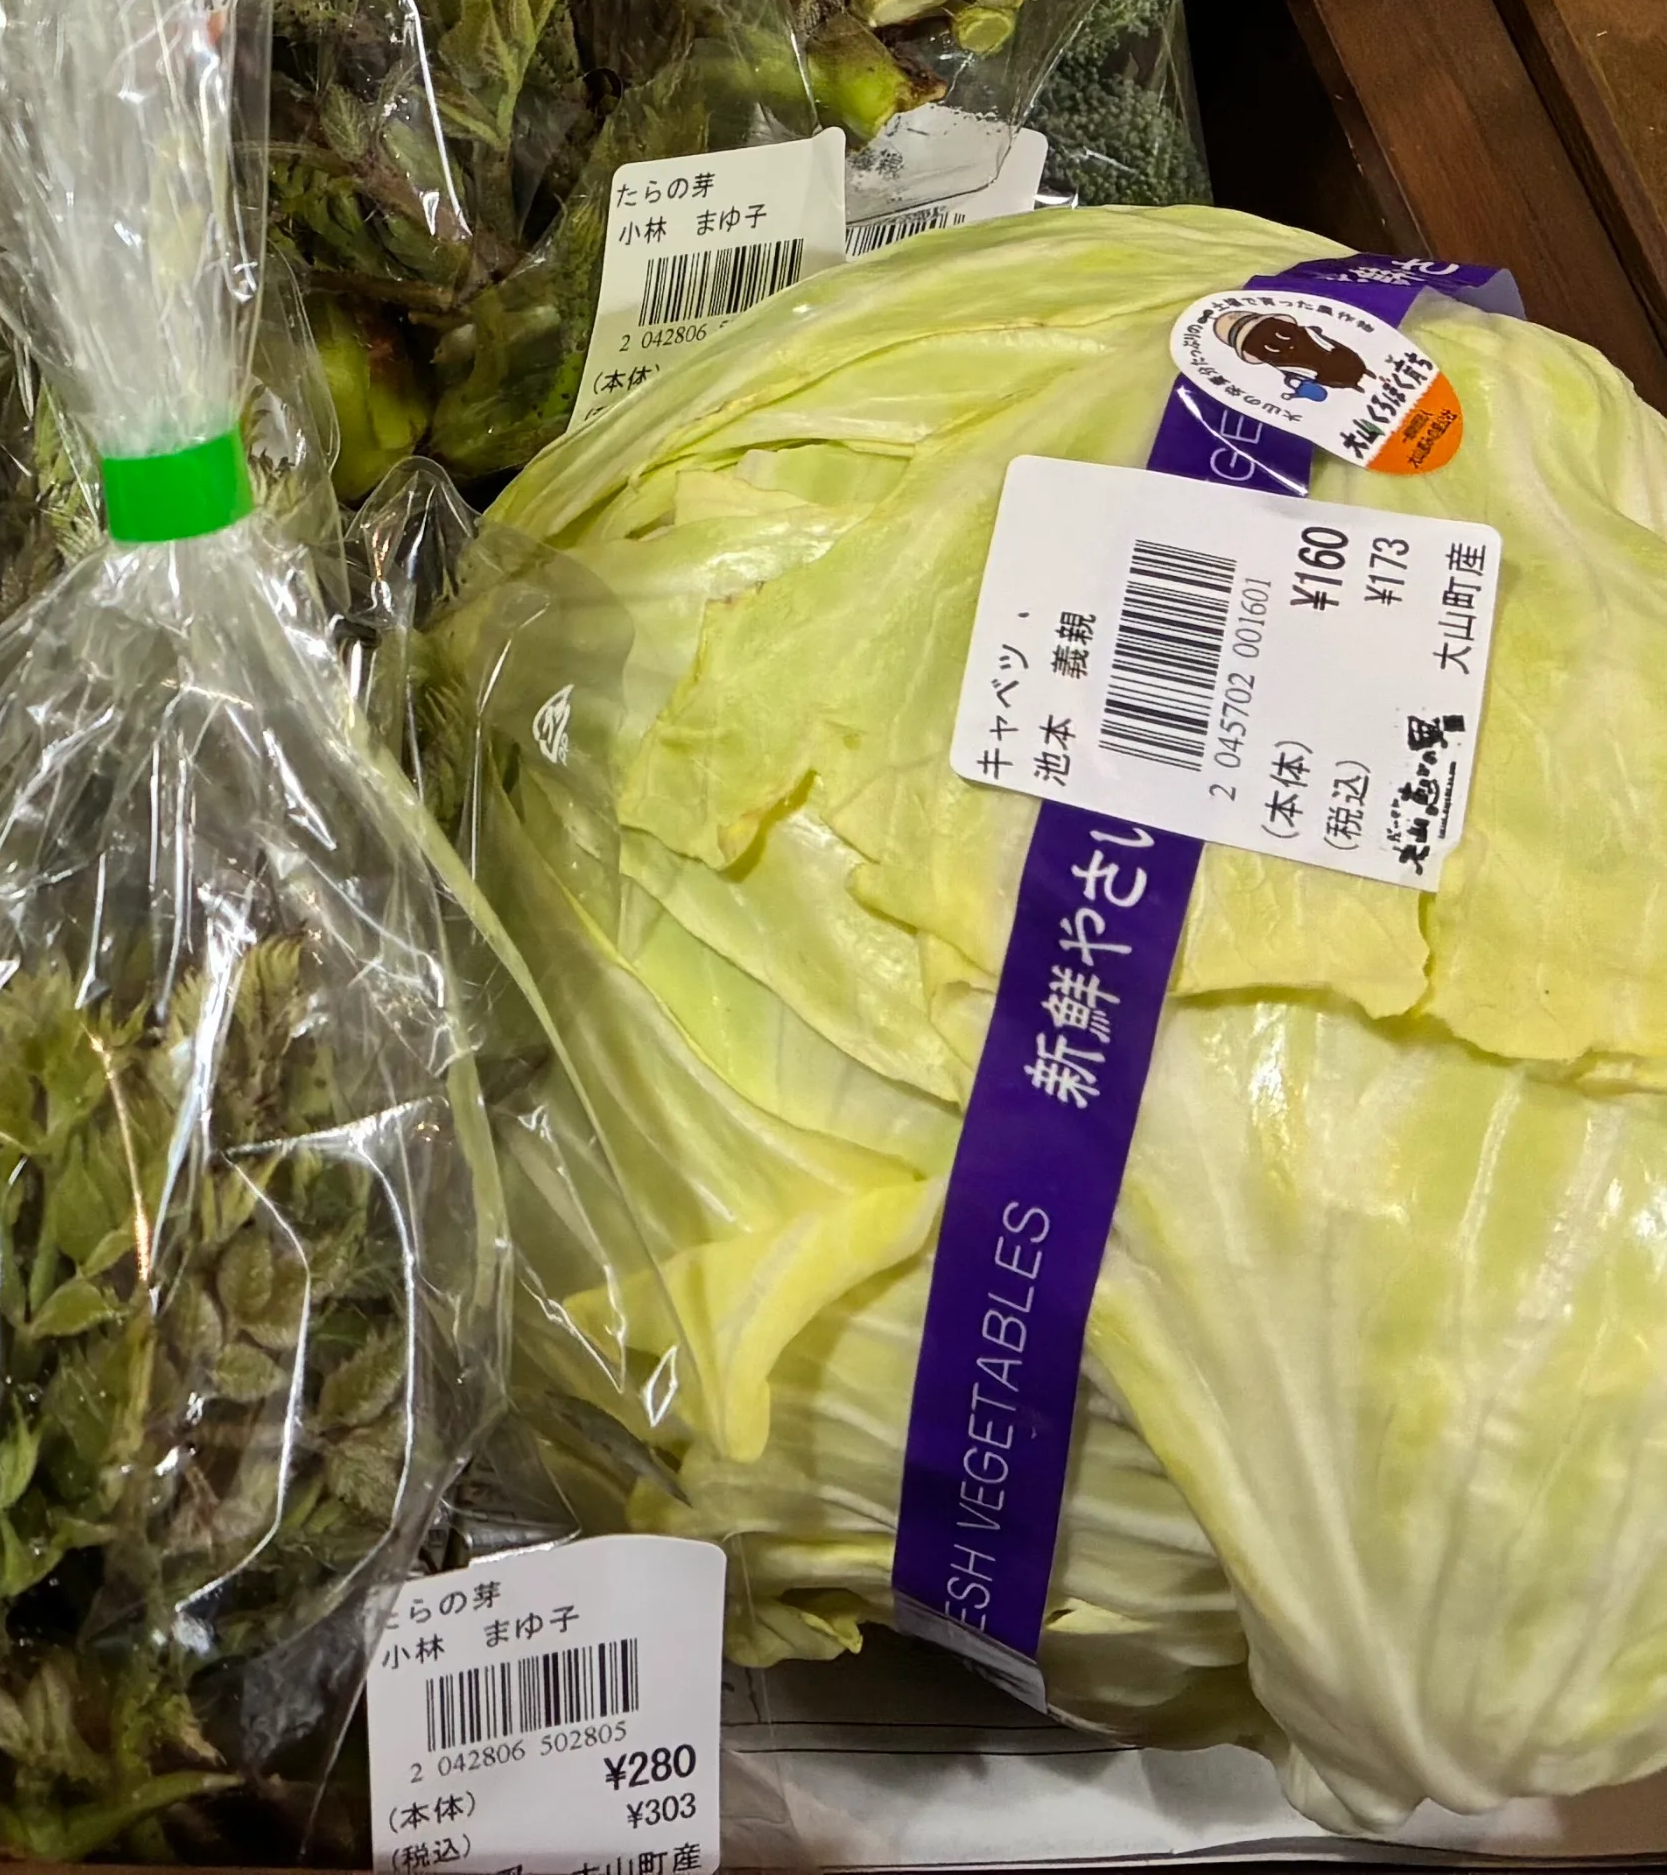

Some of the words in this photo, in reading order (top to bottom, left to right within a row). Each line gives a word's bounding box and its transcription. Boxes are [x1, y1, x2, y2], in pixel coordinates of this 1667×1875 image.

[616, 172, 715, 209] たらの芽
[619, 214, 666, 246] 小林
[696, 205, 767, 237] まゆ子
[641, 323, 707, 350] 042806
[1340, 352, 1434, 460] 大山くろぼく育ち
[1048, 606, 1099, 681] 義親
[1230, 574, 1274, 660] 001601
[1430, 539, 1492, 674] 大山町産
[973, 641, 1033, 783] キャベツ
[1212, 669, 1258, 770] 045702
[1258, 734, 1316, 844] (本体)
[1288, 523, 1352, 614] ¥160
[1320, 755, 1374, 855] (税込)
[1362, 533, 1414, 608] ¥173
[1031, 711, 1079, 788] 池本
[958, 1200, 1053, 1534] VEGETABLES
[381, 1634, 446, 1671] 小林
[484, 1605, 580, 1647] まゆ子
[388, 1790, 477, 1835] (本体)
[603, 1743, 697, 1790] ¥280
[438, 1739, 526, 1777] 042806
[539, 1721, 628, 1757] 502805
[392, 1833, 471, 1871] (税込)
[626, 1792, 697, 1829] ¥303
